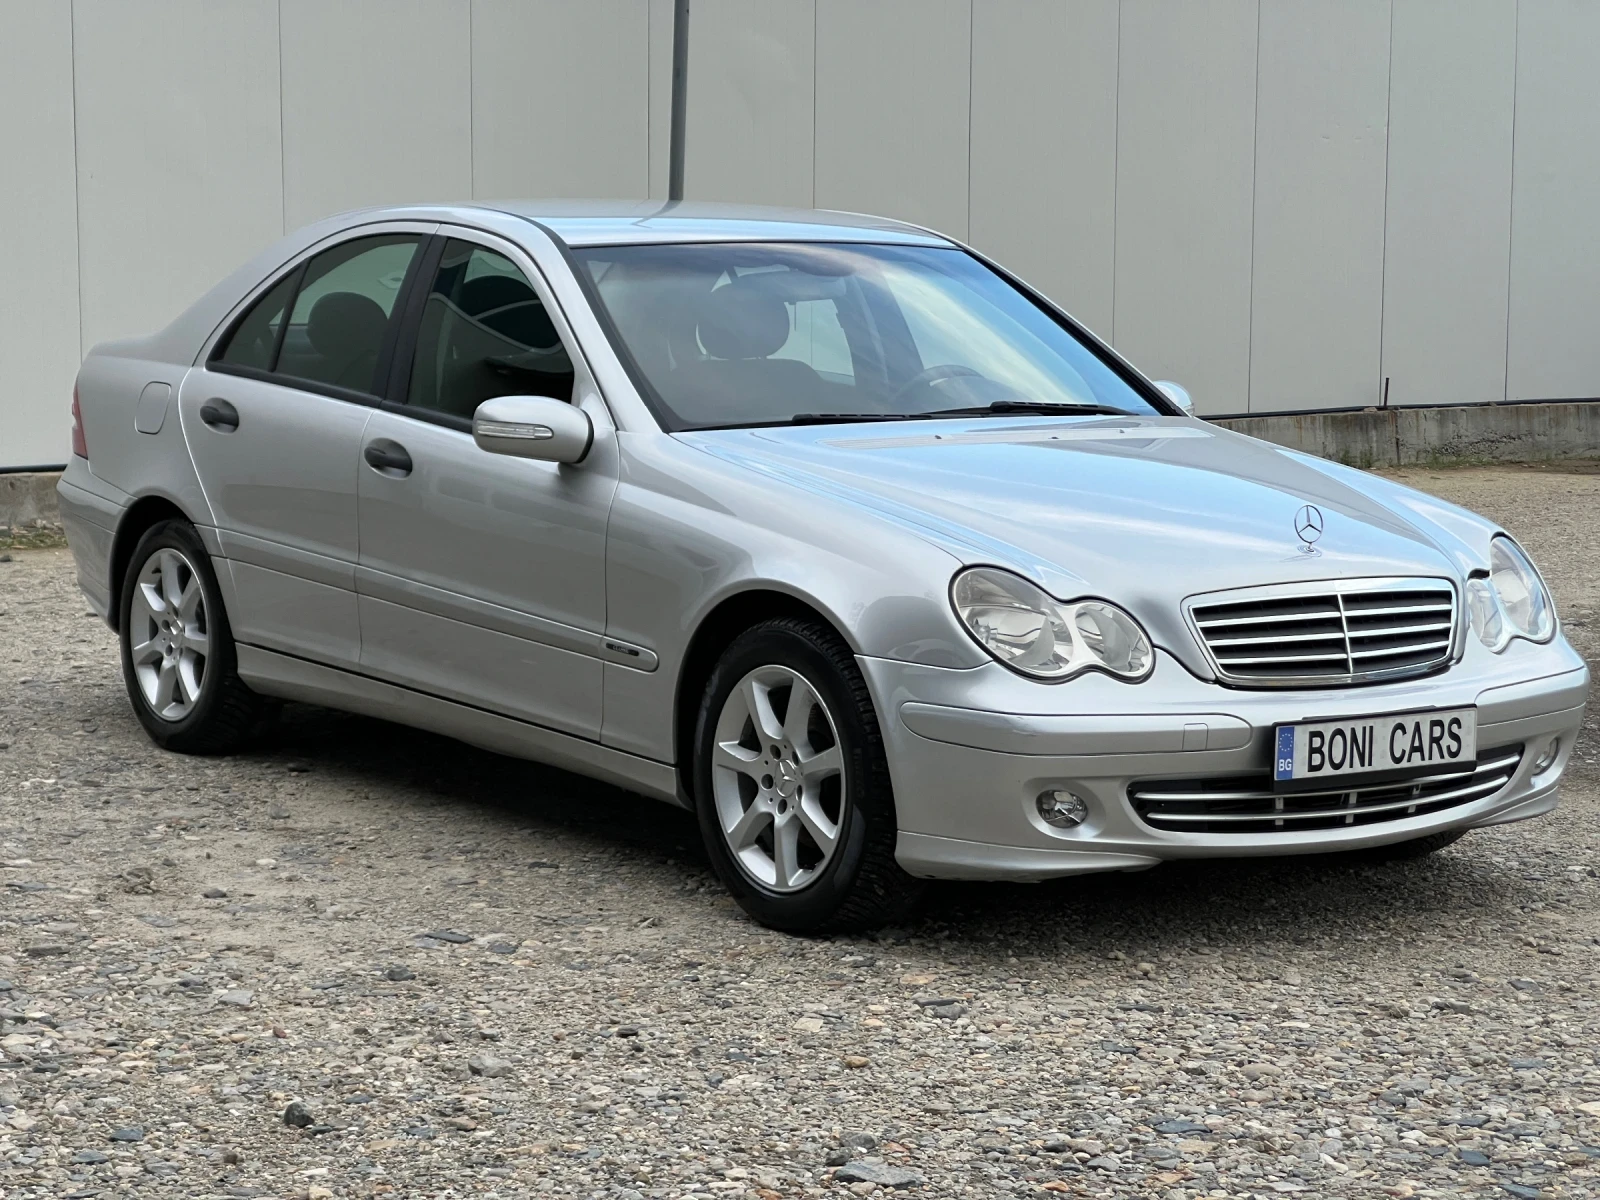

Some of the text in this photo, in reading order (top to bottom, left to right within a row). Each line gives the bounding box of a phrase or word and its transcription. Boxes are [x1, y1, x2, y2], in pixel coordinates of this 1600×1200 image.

[1308, 717, 1462, 772] BONI CARS
[1278, 758, 1292, 771] BG
